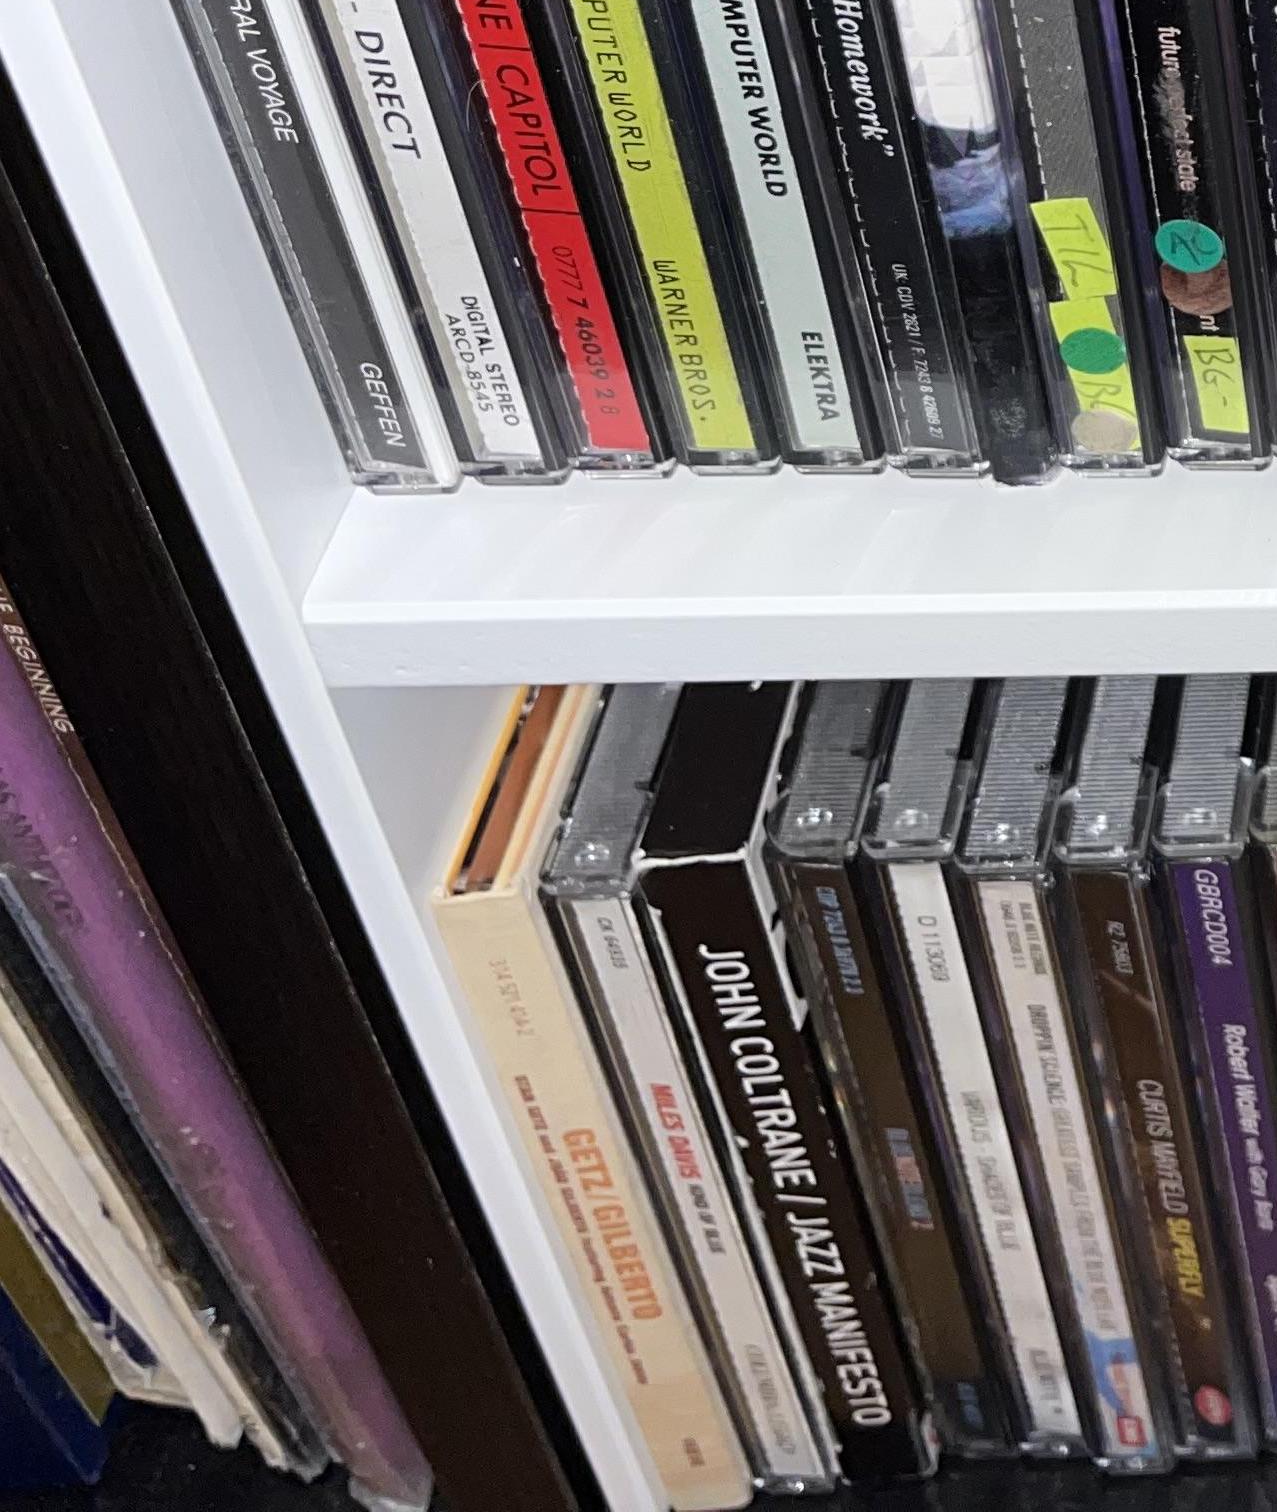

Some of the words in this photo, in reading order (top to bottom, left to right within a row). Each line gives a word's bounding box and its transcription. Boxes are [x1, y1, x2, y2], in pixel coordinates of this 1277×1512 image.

[245, 48, 300, 144] VOYAGE
[353, 30, 422, 160] DIRECT
[495, 64, 563, 197] CAPITOL
[607, 92, 652, 173] WORLD
[747, 107, 789, 198] WORLD
[651, 259, 699, 347] WARNER
[677, 352, 717, 422] BROS.
[896, 285, 916, 311] CDV
[444, 313, 494, 412] ARCD-8545
[459, 295, 496, 357] DIGITAL
[484, 362, 521, 427] STEREO
[574, 316, 607, 378] 46039
[800, 330, 840, 421] ELEKTRA
[359, 362, 408, 448] GEFFEN
[2, 623, 76, 735] BEGINNING
[1193, 868, 1233, 966] GBRCD004
[697, 943, 767, 1030] JOHN
[1222, 1023, 1255, 1082] Robert
[649, 1083, 686, 1132] MILES
[729, 1036, 818, 1189] COLTRANE
[667, 1135, 702, 1180] DAVIS
[1136, 1078, 1174, 1139] CURTIS
[1165, 1217, 1204, 1297] SUPERFLY
[561, 1128, 664, 1321] GETZ/GILBERTO
[786, 1212, 845, 1278] JAZZ
[808, 1281, 892, 1426] MANIFESTO
